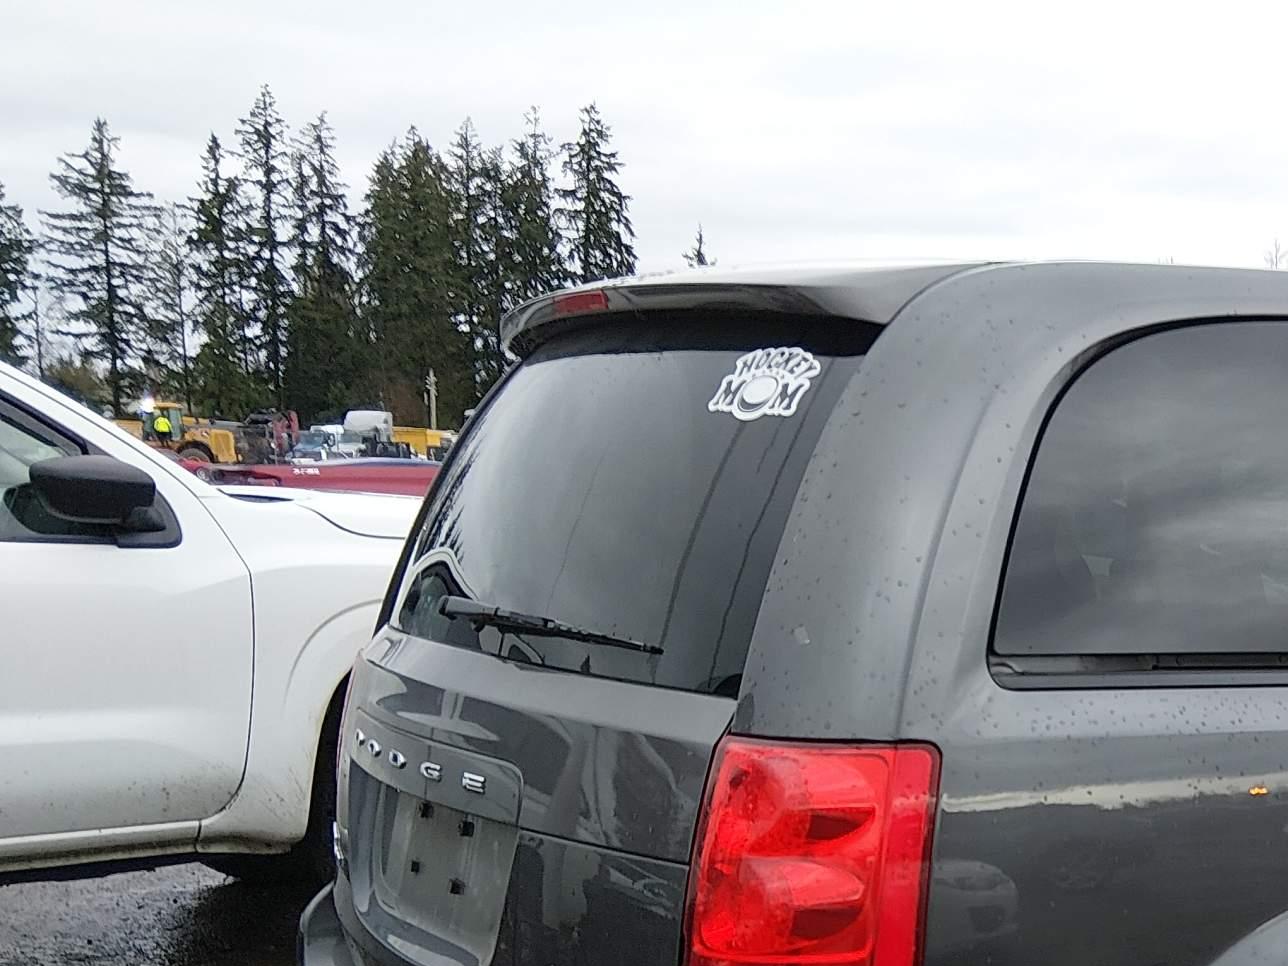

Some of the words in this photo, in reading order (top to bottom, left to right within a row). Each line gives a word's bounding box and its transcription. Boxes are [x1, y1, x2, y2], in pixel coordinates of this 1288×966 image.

[736, 348, 821, 380] HOCKEY
[709, 374, 811, 421] MOM
[355, 728, 486, 794] DODGE
